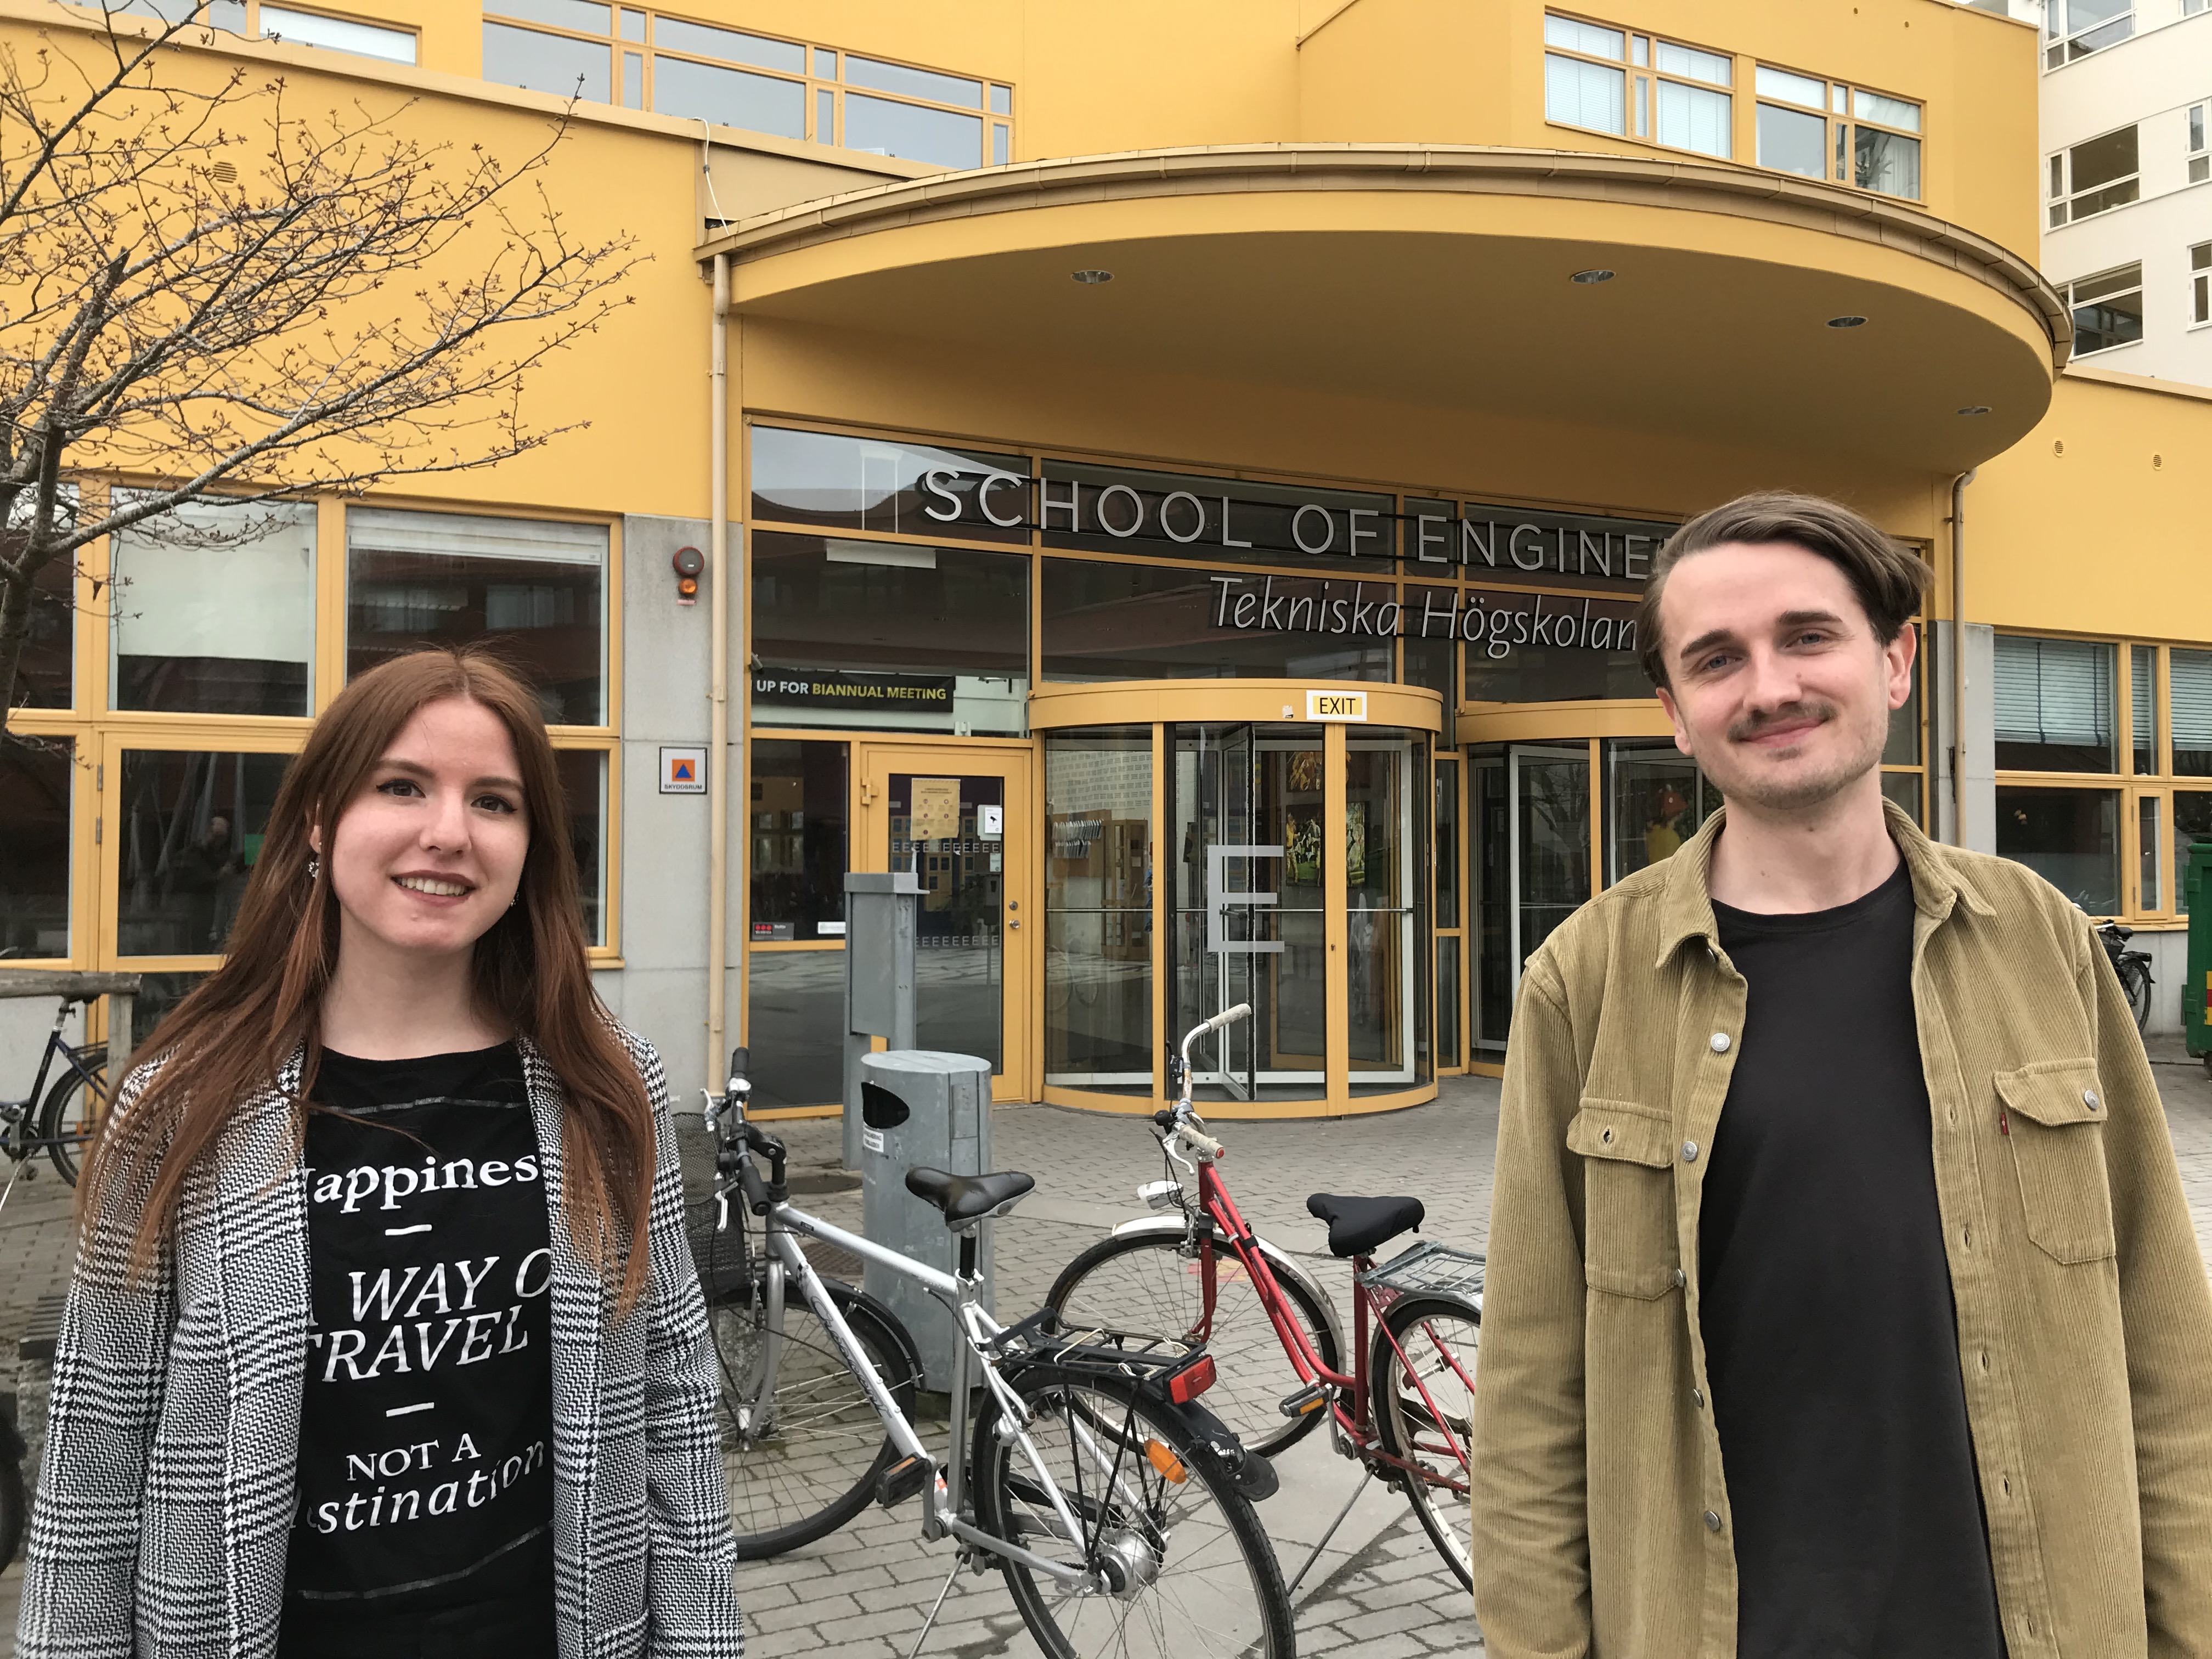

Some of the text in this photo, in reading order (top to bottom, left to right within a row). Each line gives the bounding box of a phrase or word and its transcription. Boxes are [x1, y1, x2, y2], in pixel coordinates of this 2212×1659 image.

[924, 469, 1672, 580] SCHOOL OF ENGINE
[1210, 575, 1637, 659] Tekniska Högskolan
[756, 679, 947, 700] UP FOR BIANNUAL MEETING
[1319, 697, 1356, 715] EXIT
[1207, 845, 1285, 953] E
[306, 1154, 539, 1214] appines
[348, 1256, 500, 1322] WAY
[346, 1432, 482, 1481] NOT A
